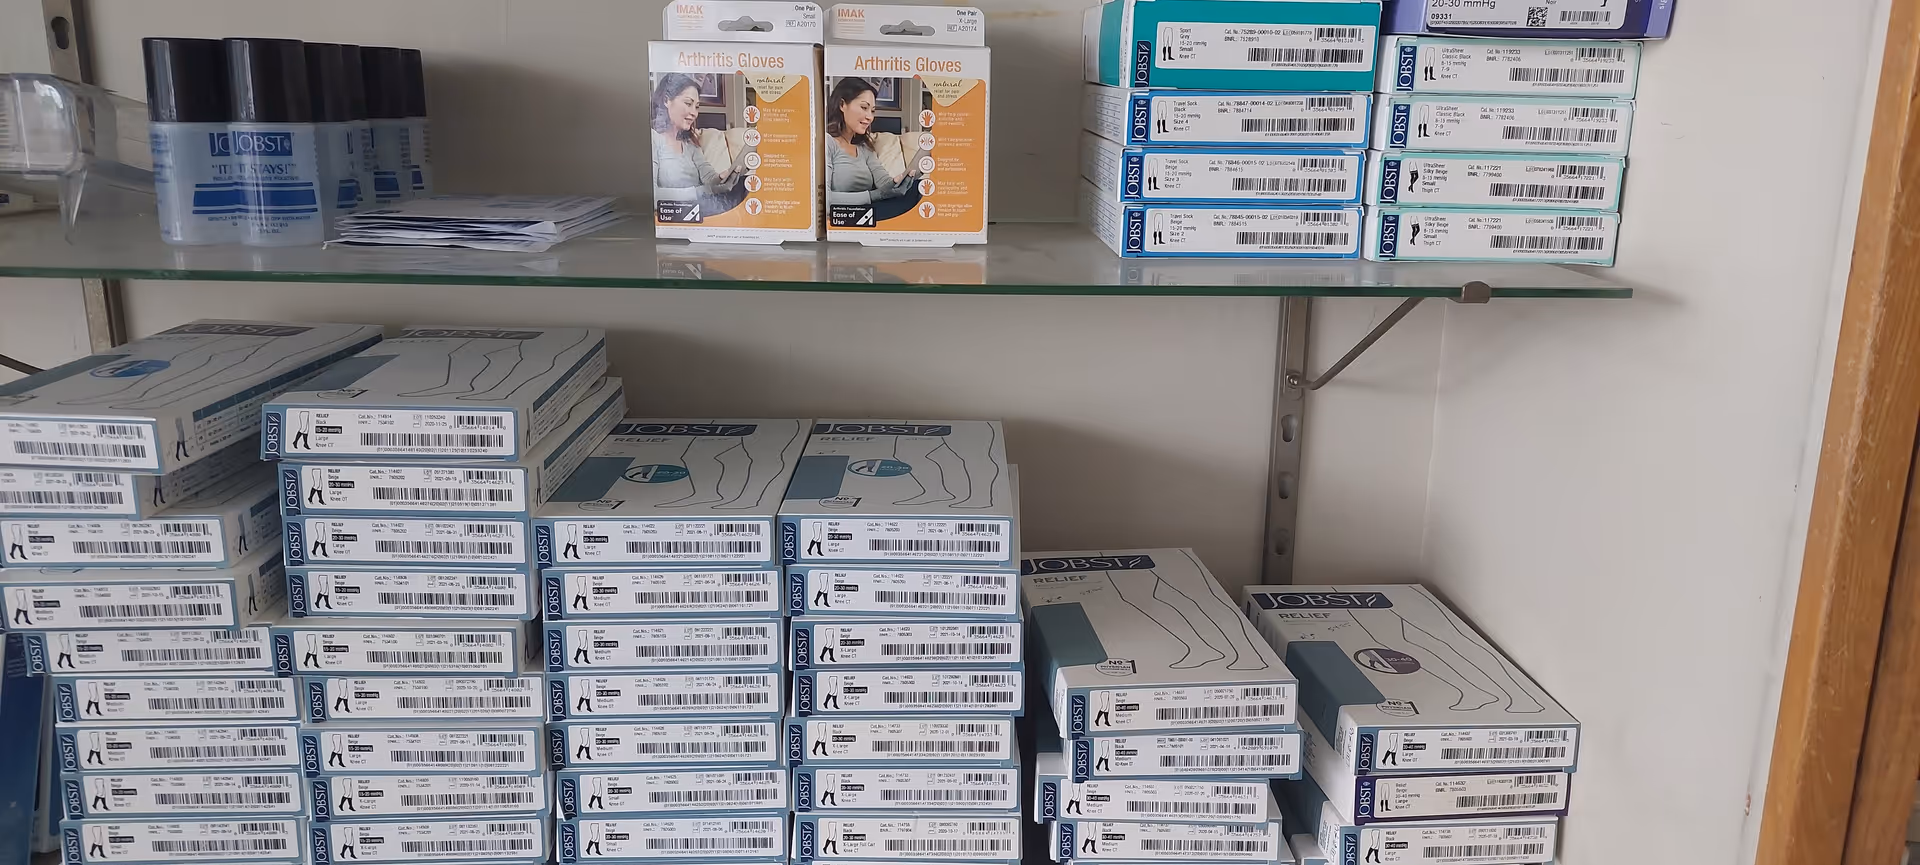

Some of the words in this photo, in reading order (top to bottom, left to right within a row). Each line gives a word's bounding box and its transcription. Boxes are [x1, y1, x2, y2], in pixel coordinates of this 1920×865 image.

[676, 4, 703, 14] IMAK
[838, 9, 865, 18] IMAK
[1432, 0, 1461, 9] 20-30
[1463, 0, 1496, 10] mmHg
[678, 52, 733, 67] Arthritis
[738, 52, 784, 68] Gloves
[855, 56, 910, 71] Arthritis
[916, 57, 961, 72] Gloves
[1135, 51, 1148, 87] JOBST
[1396, 51, 1413, 91] JOBST
[933, 79, 962, 87] natural
[1132, 104, 1147, 142] JOBST
[1390, 109, 1407, 148] JOBST
[235, 131, 284, 153] JOBST
[1125, 162, 1140, 198] JOBST
[1380, 166, 1398, 203] JOBST
[1127, 217, 1141, 252] JOBST
[1379, 221, 1395, 257] JOBST
[265, 422, 279, 455] JOBST
[623, 424, 729, 435] JOBST
[825, 424, 924, 434] JOBST
[285, 478, 299, 511] JOBST
[289, 531, 301, 562] JOBST
[538, 535, 552, 564] JOBST
[782, 531, 795, 560] JOBST
[1030, 558, 1124, 574] JOBST
[1033, 575, 1087, 584] RELIEF
[292, 584, 306, 613] JOBST
[548, 586, 562, 616] JOBST
[791, 582, 804, 612] JOBST
[1265, 593, 1362, 608] JOBST
[30, 644, 46, 674] JOBST
[278, 643, 292, 673] JOBST
[549, 638, 563, 667] JOBST
[796, 637, 809, 666] JOBST
[60, 692, 76, 721] JOBST
[312, 690, 326, 721] JOBST
[553, 688, 565, 717] JOBST
[799, 685, 811, 712] JOBST
[1071, 704, 1085, 734] JOBST
[63, 742, 78, 772] JOBST
[305, 743, 319, 773] JOBST
[552, 737, 565, 766] JOBST
[789, 733, 802, 761] JOBST
[1358, 741, 1372, 771] JOBST
[1075, 748, 1089, 779] JOBST
[67, 786, 84, 816] JOBST
[316, 789, 329, 818] JOBST
[564, 788, 575, 816] JOBST
[798, 781, 810, 809] JOBST
[1043, 790, 1056, 819] JOBST
[1357, 785, 1371, 818] JOBST
[66, 836, 82, 865] JOBST
[315, 836, 328, 864] JOBST
[562, 832, 575, 862] JOBST
[800, 831, 813, 858] JOBST
[1060, 830, 1073, 860] JOBST
